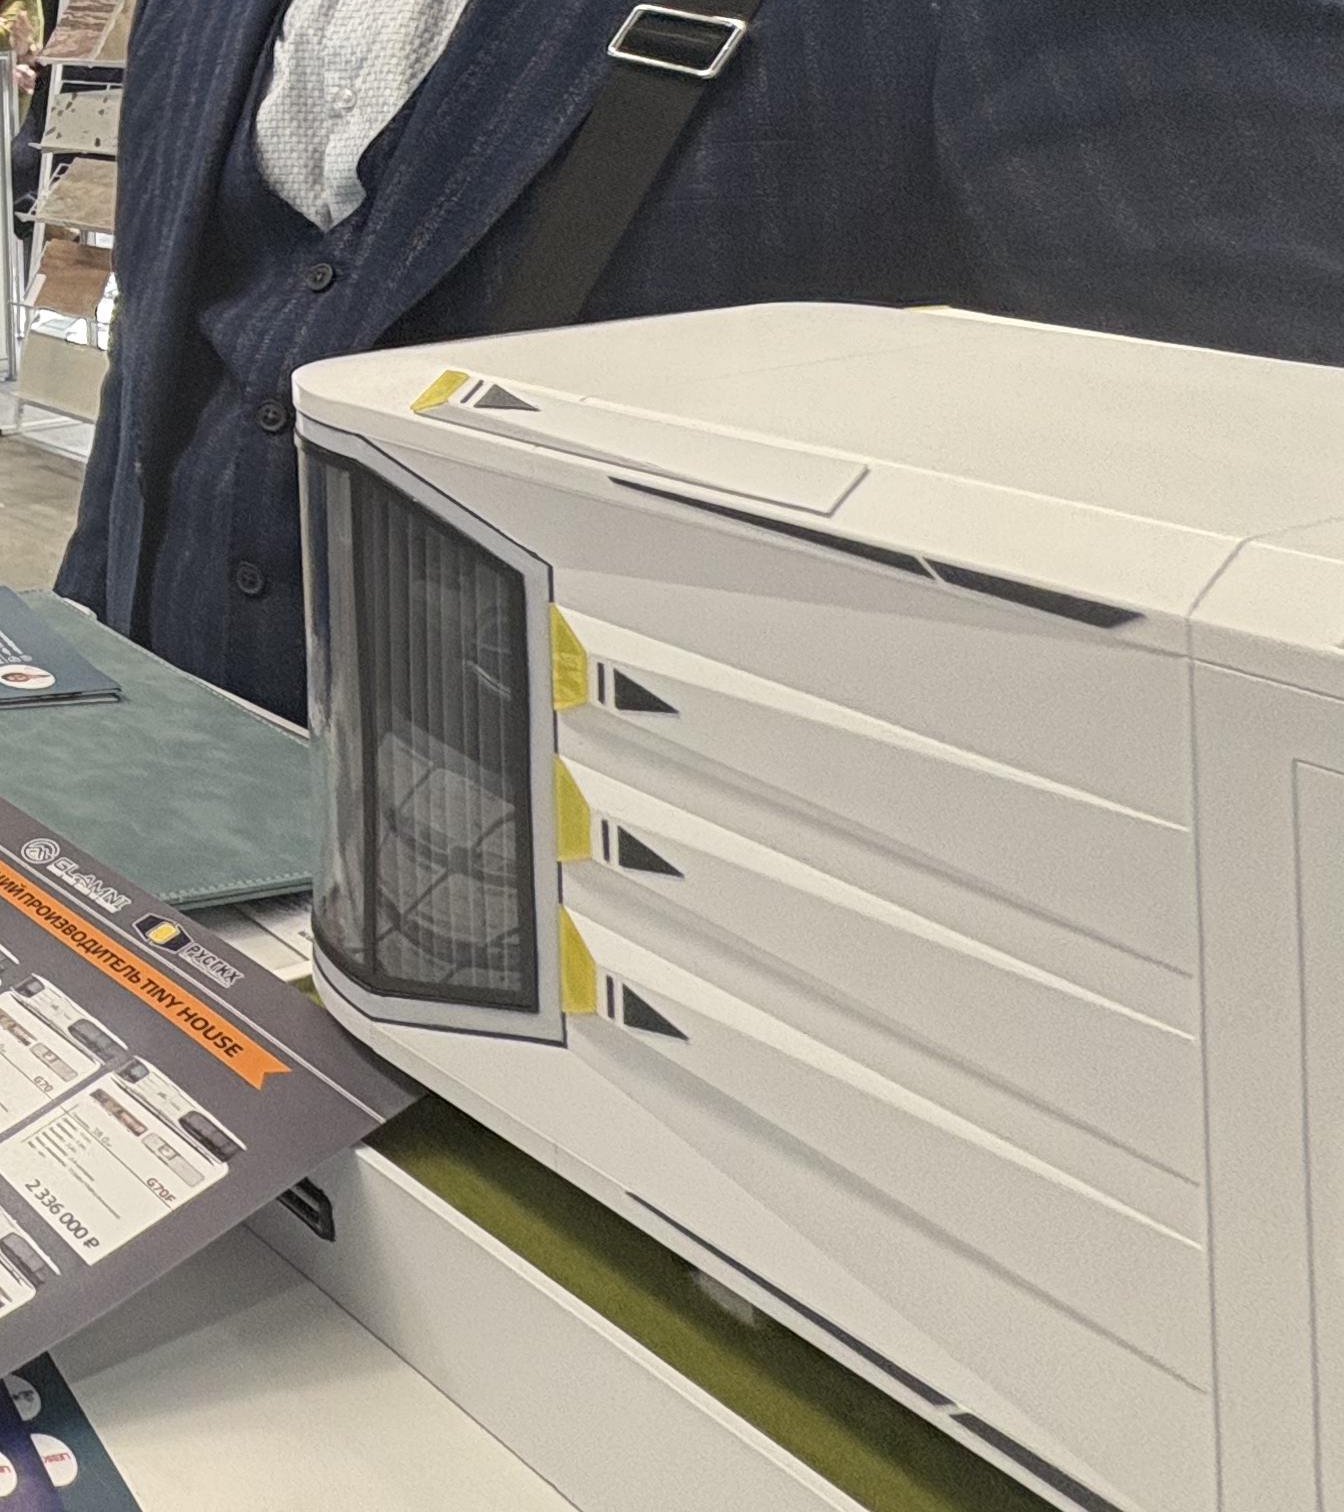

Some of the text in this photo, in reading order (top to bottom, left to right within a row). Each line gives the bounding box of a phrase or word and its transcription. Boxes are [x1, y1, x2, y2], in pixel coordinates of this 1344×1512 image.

[17, 892, 141, 984] ПРОИЗВОДИТЕЛЬ
[139, 977, 184, 1009] TINY
[176, 1006, 244, 1058] HOUSE
[32, 1073, 55, 1095] G70
[24, 1178, 41, 1193] 2
[34, 1187, 65, 1215] 336
[58, 1212, 89, 1240] 000
[144, 1174, 178, 1206] G70F
